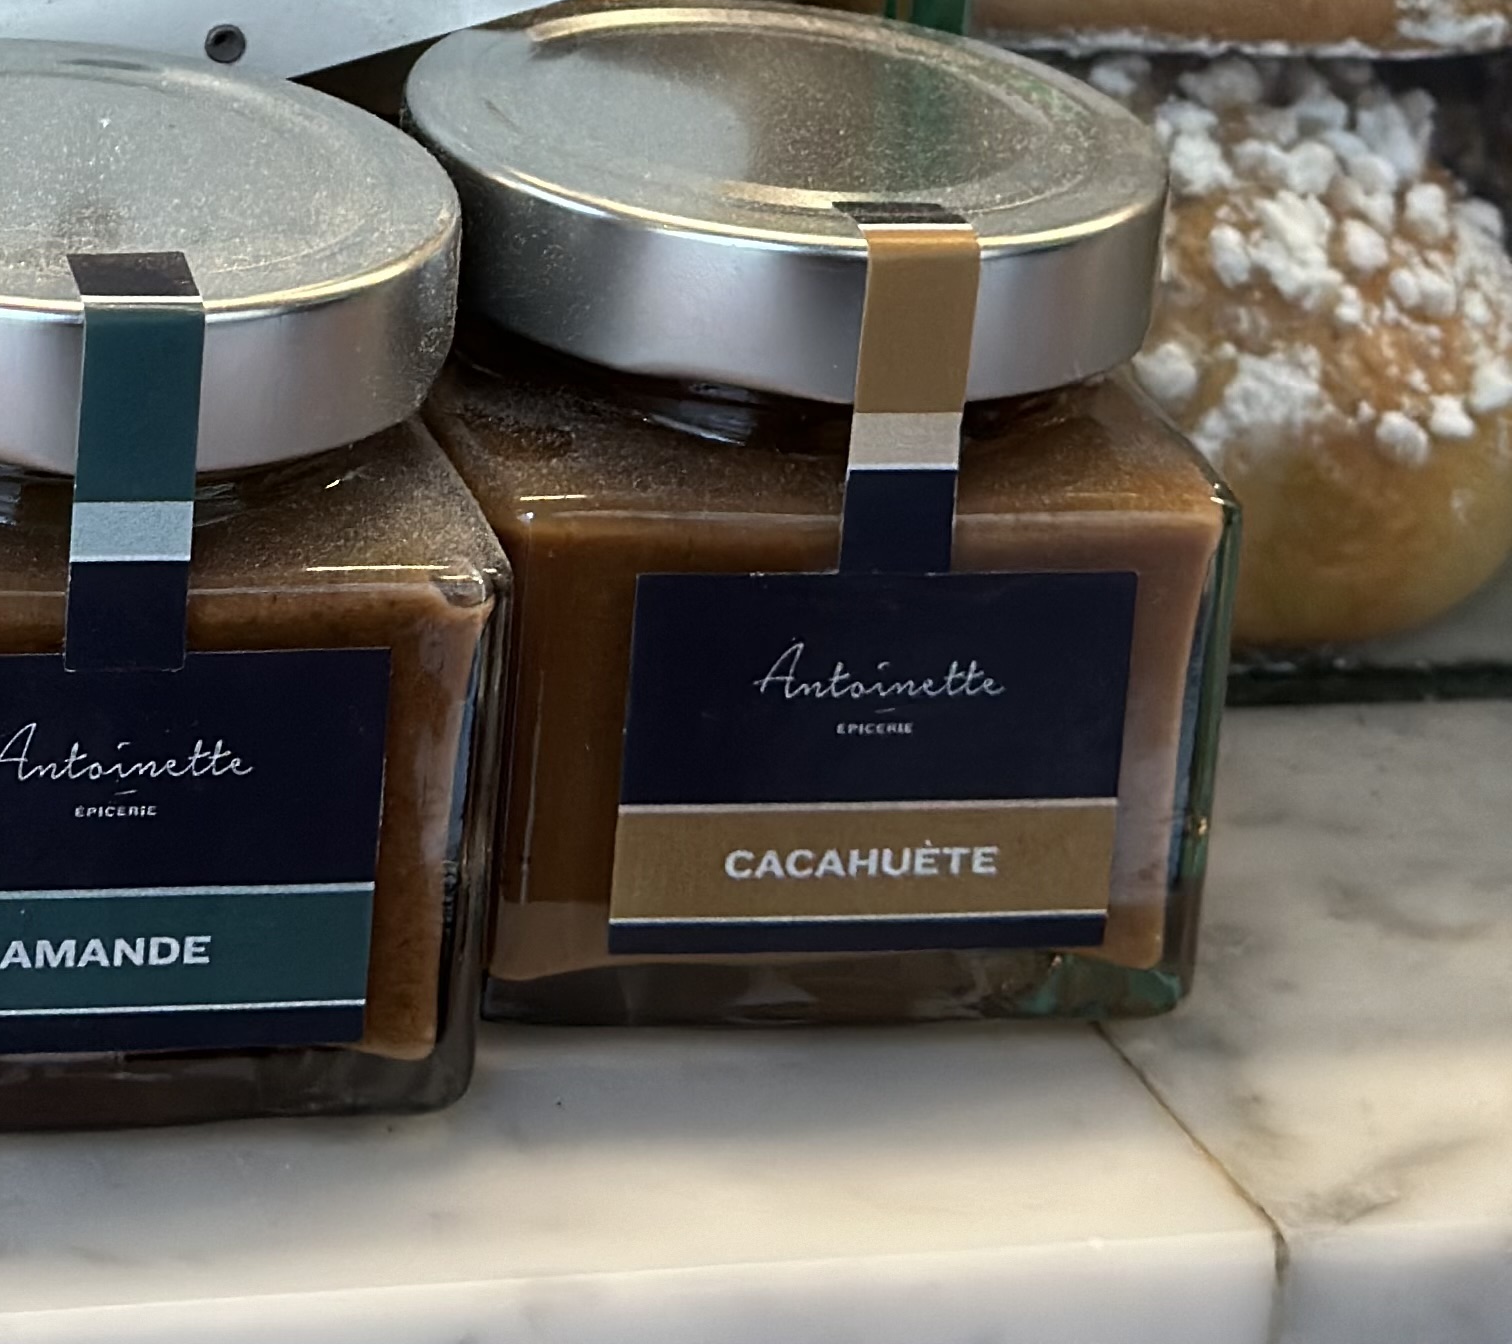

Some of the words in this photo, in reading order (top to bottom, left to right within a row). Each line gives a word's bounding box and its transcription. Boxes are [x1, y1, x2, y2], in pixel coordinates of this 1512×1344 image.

[753, 639, 1005, 699] Antoinette
[724, 839, 1001, 880] CACAHUÈTE
[0, 935, 211, 969] AMANDE
